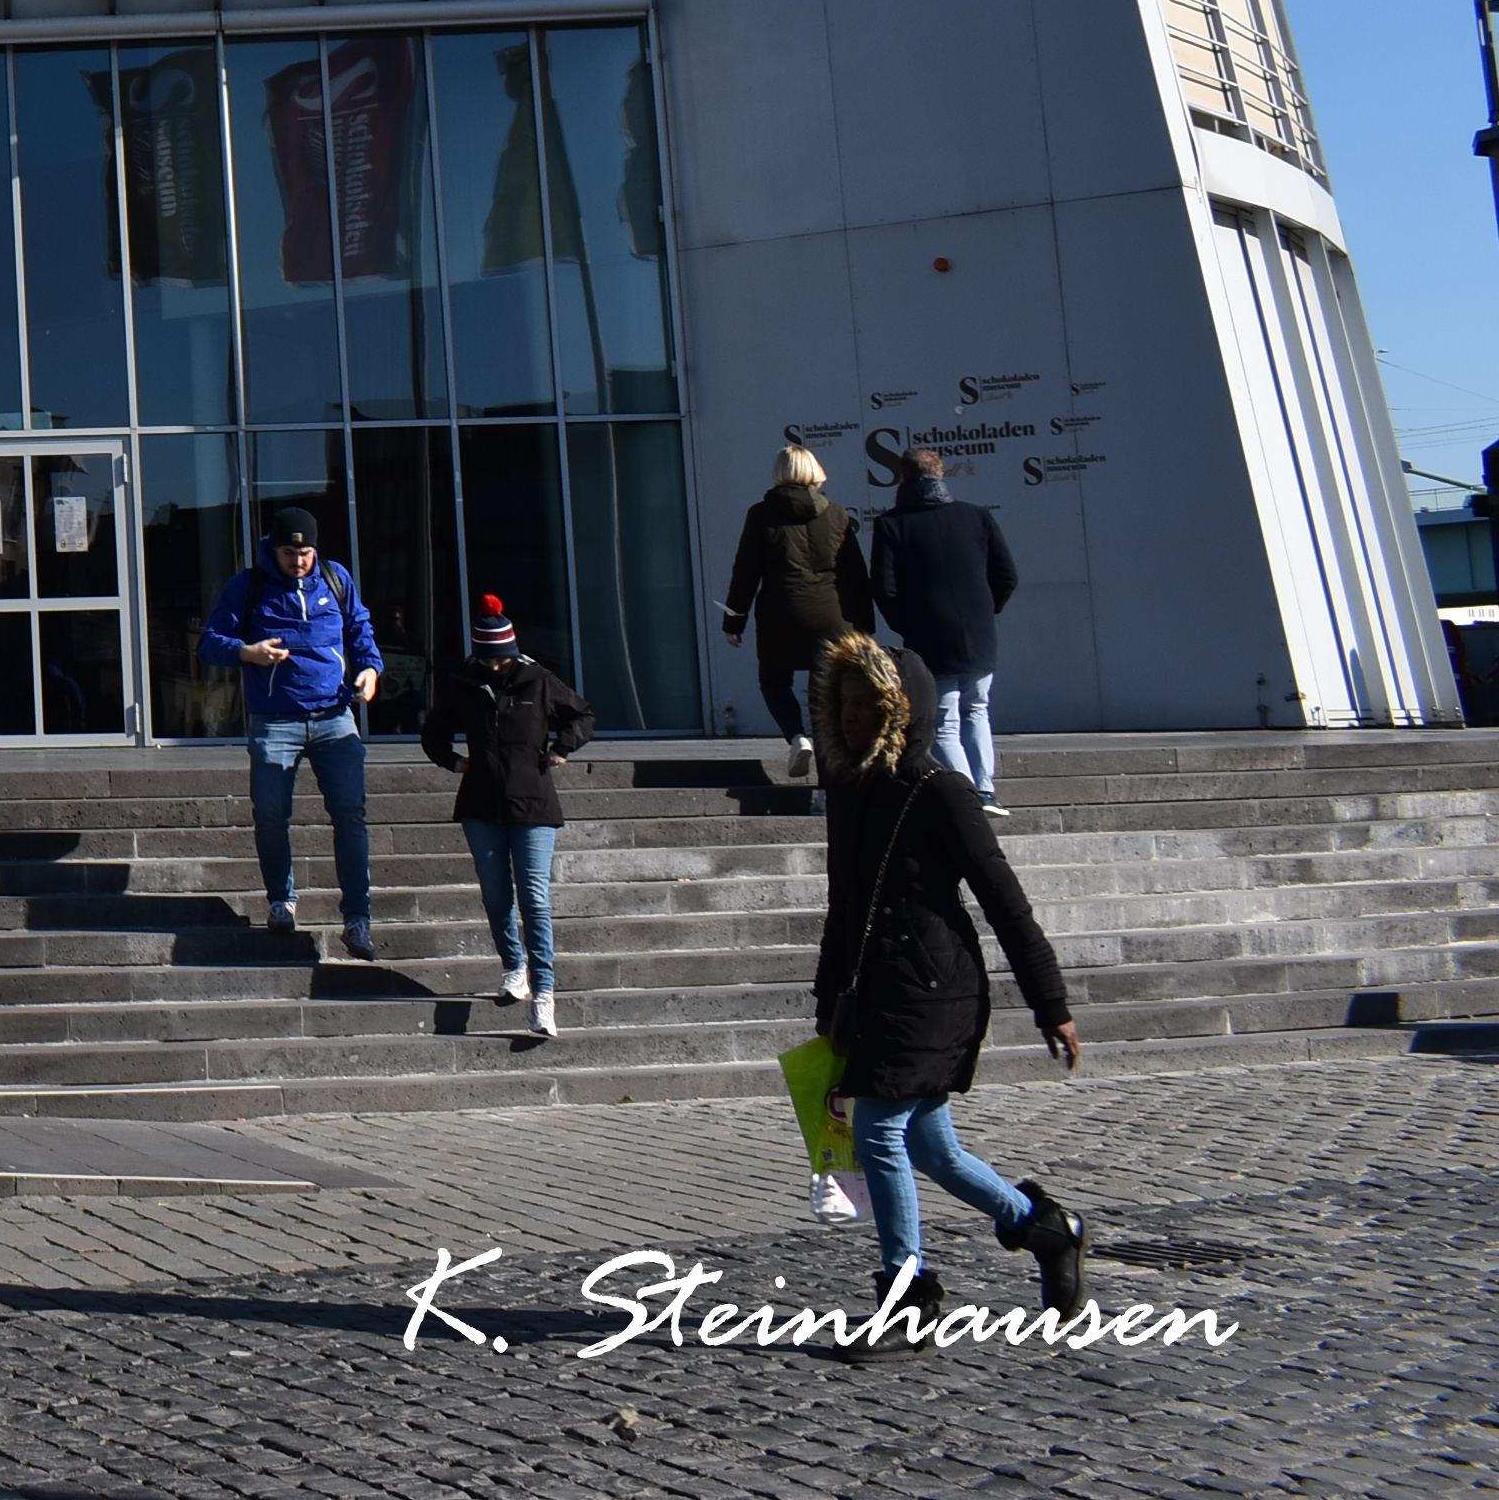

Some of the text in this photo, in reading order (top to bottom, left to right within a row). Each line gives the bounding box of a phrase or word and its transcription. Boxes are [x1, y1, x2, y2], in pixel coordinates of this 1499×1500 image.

[982, 373, 1040, 384] schokoladen
[959, 376, 979, 405] S
[871, 393, 882, 410] S
[805, 421, 859, 432] schokoladen
[913, 421, 1035, 445] schokoladen
[1050, 417, 1063, 436] S
[865, 428, 901, 487] S
[919, 442, 996, 457] useum
[1046, 454, 1106, 464] schokoladen
[1023, 457, 1043, 486] S
